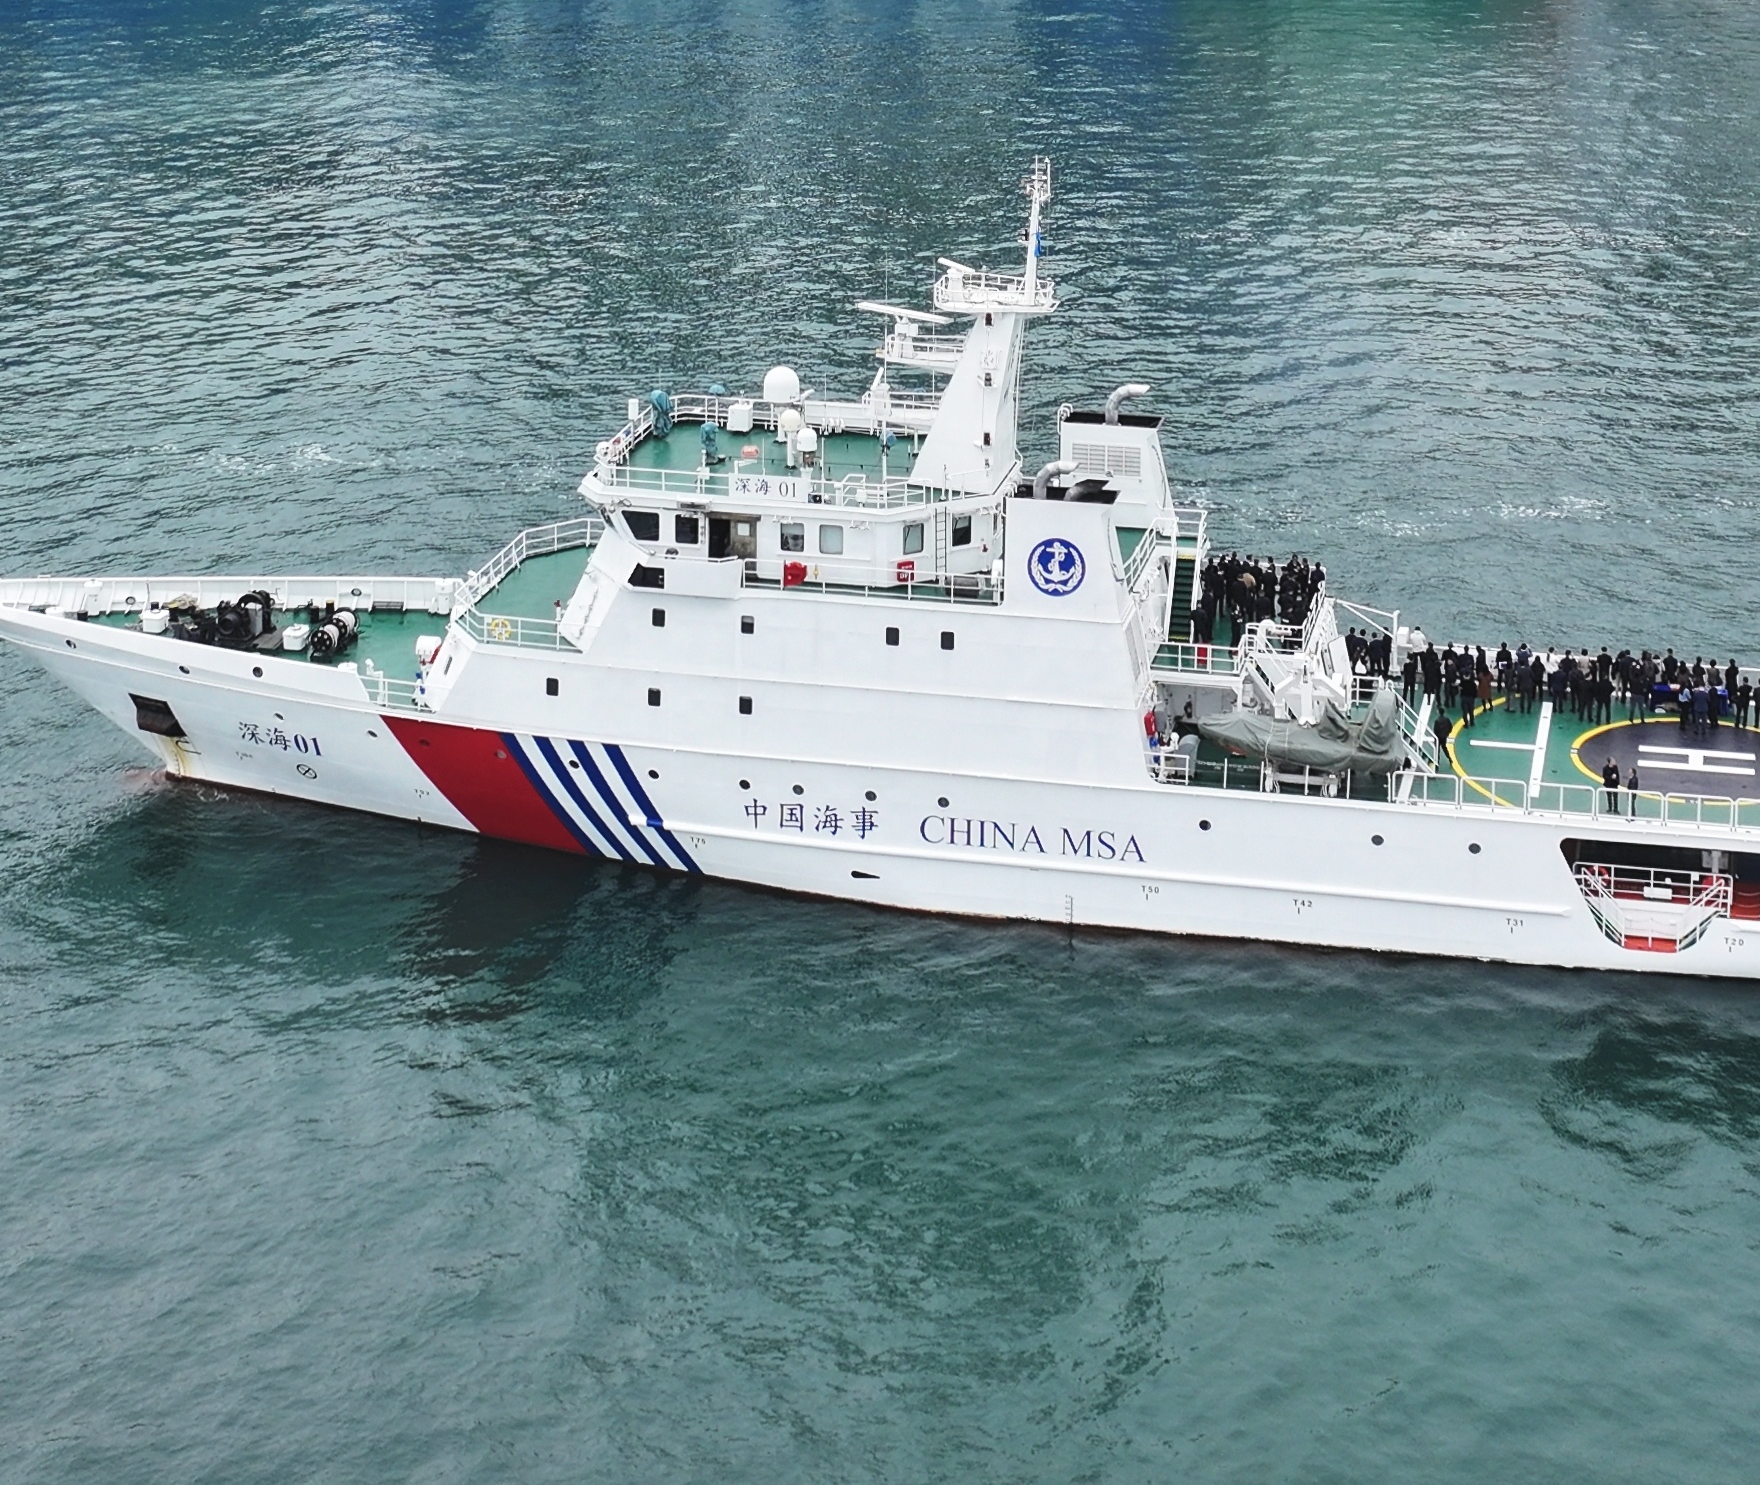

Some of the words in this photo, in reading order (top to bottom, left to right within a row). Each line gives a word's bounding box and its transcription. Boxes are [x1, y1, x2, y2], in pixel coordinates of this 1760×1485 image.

[238, 721, 322, 756] 深海01
[1637, 744, 1757, 776] H
[743, 798, 880, 840] 中国海事
[919, 815, 1048, 854] CHINA
[1059, 827, 1148, 863] MSA
[1141, 885, 1160, 894] T50
[1293, 899, 1313, 907] T42
[1506, 918, 1524, 926] T31
[1724, 937, 1745, 946] T20
